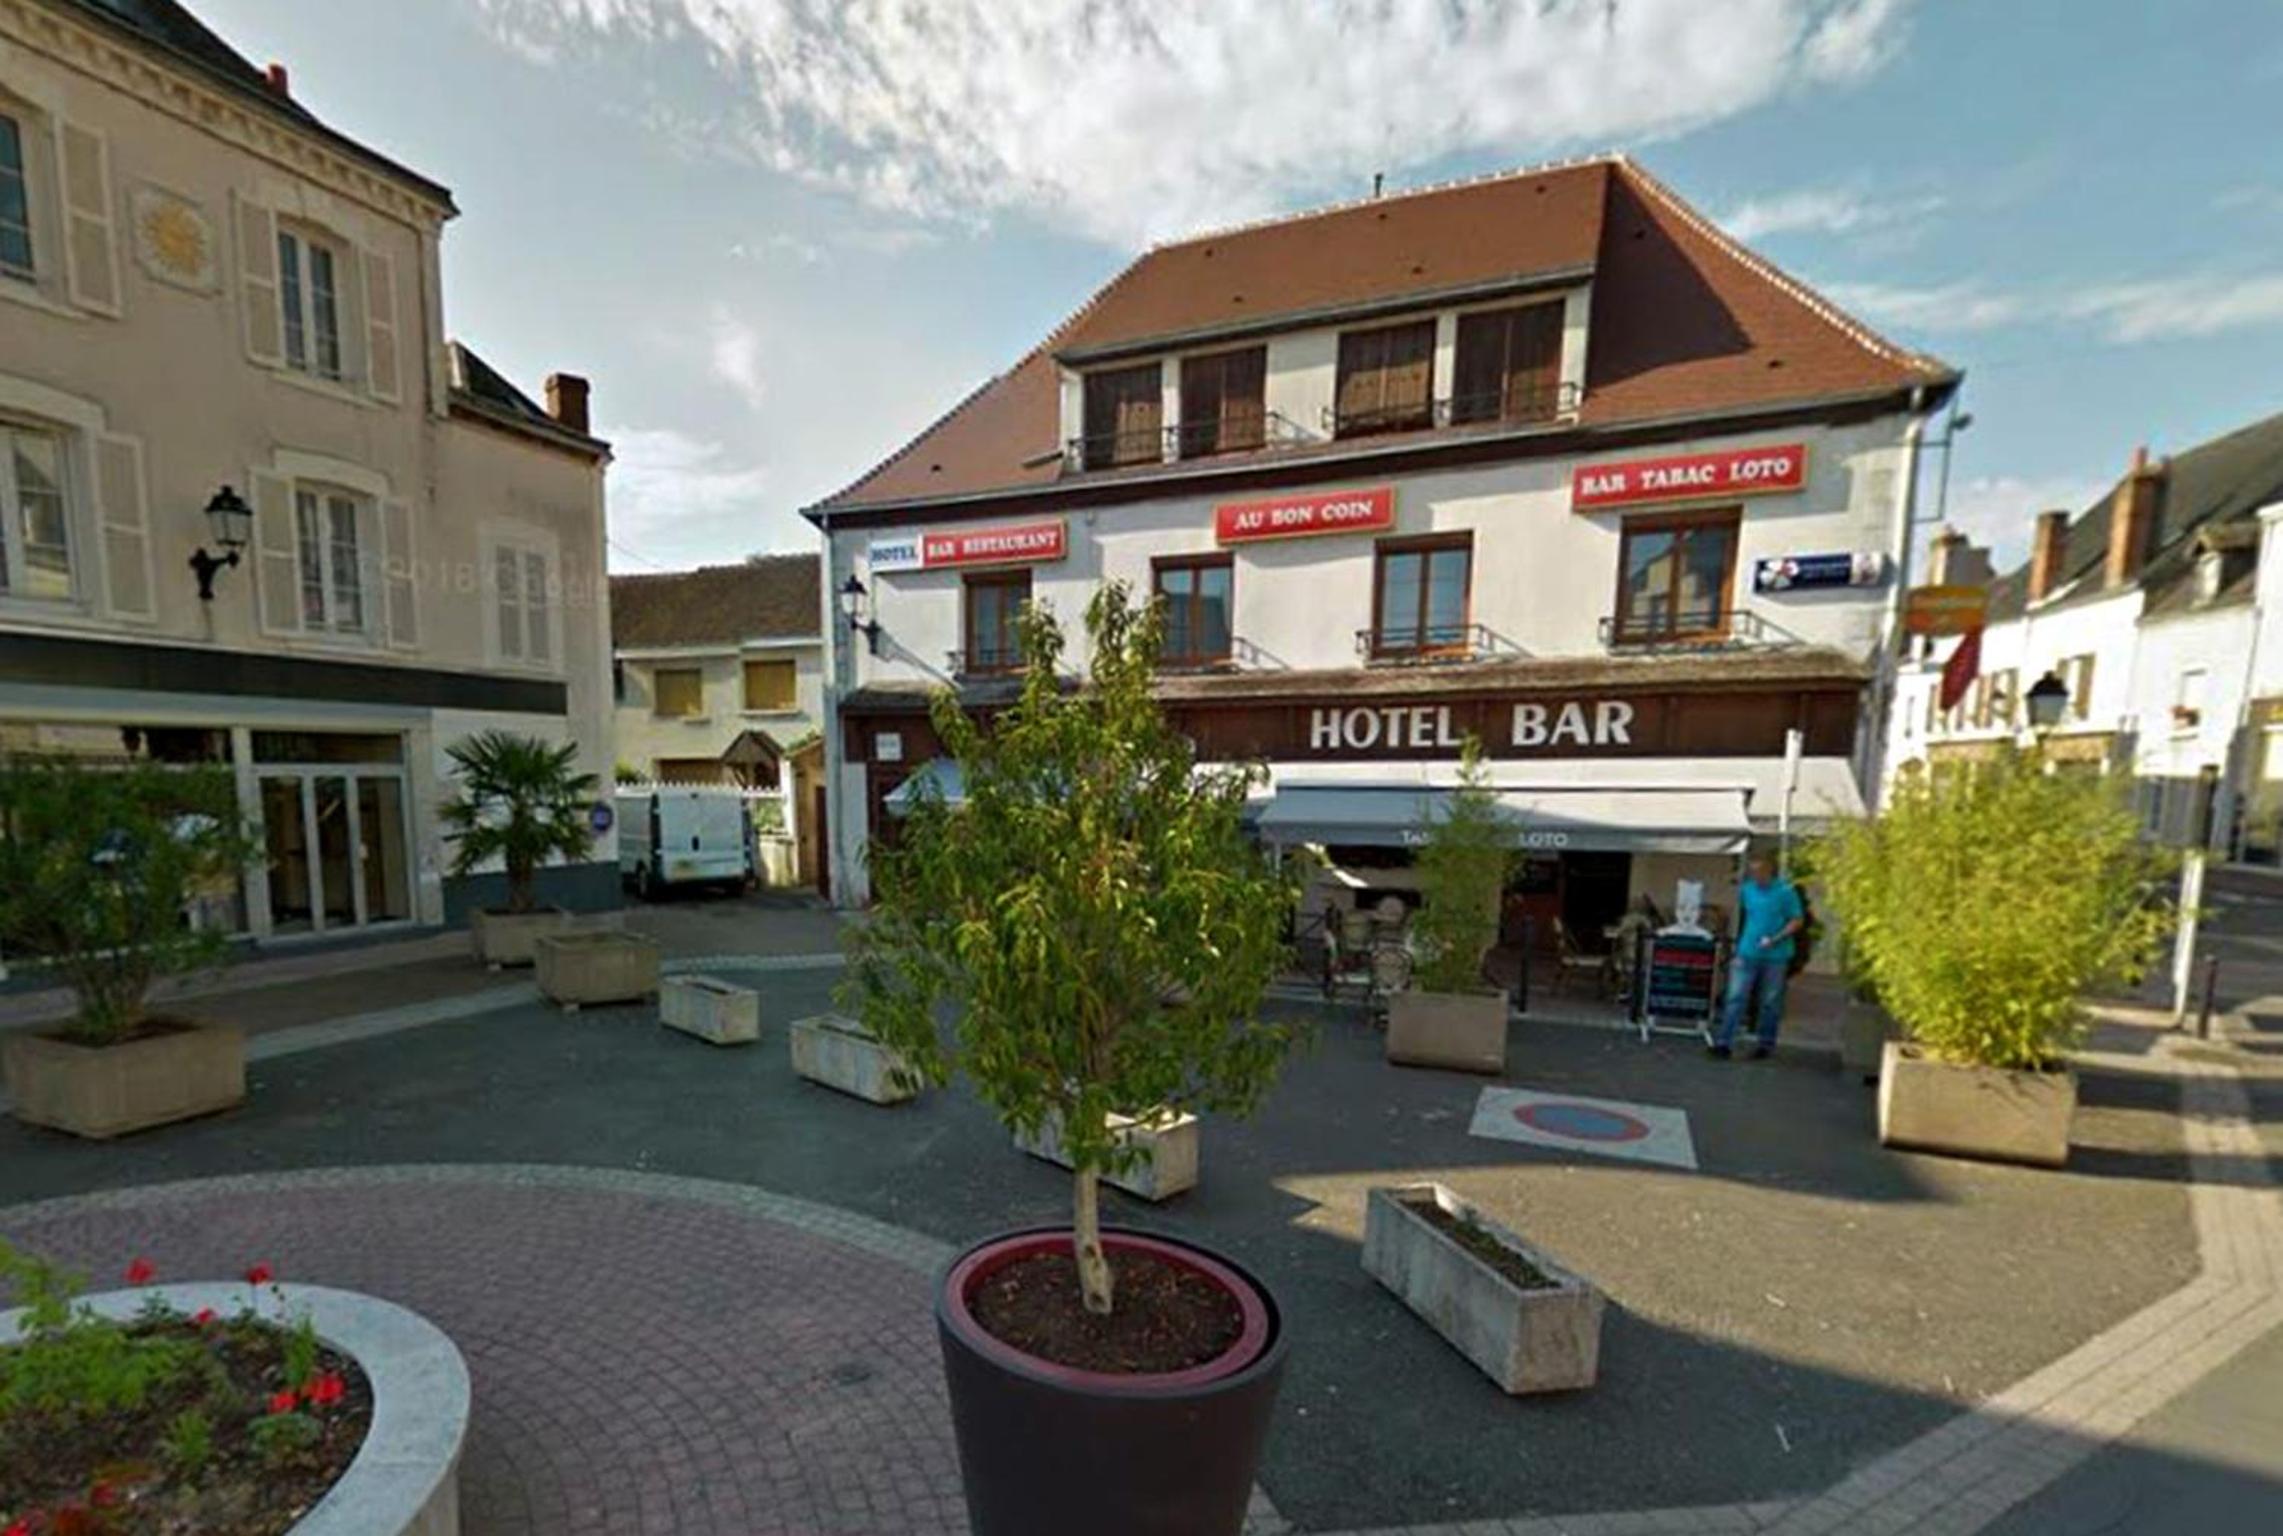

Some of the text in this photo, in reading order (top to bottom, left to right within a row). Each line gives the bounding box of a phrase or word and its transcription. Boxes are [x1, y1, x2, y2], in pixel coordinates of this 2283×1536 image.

[1581, 457, 1792, 495] BAR TABAC LOTO
[1235, 500, 1374, 530] AU BON COIN
[871, 546, 915, 562] HOTEL
[927, 531, 1059, 561] BAR RESTAURANT
[1310, 700, 1634, 749] HOTEL BAR
[1519, 831, 1568, 847] LOTO
